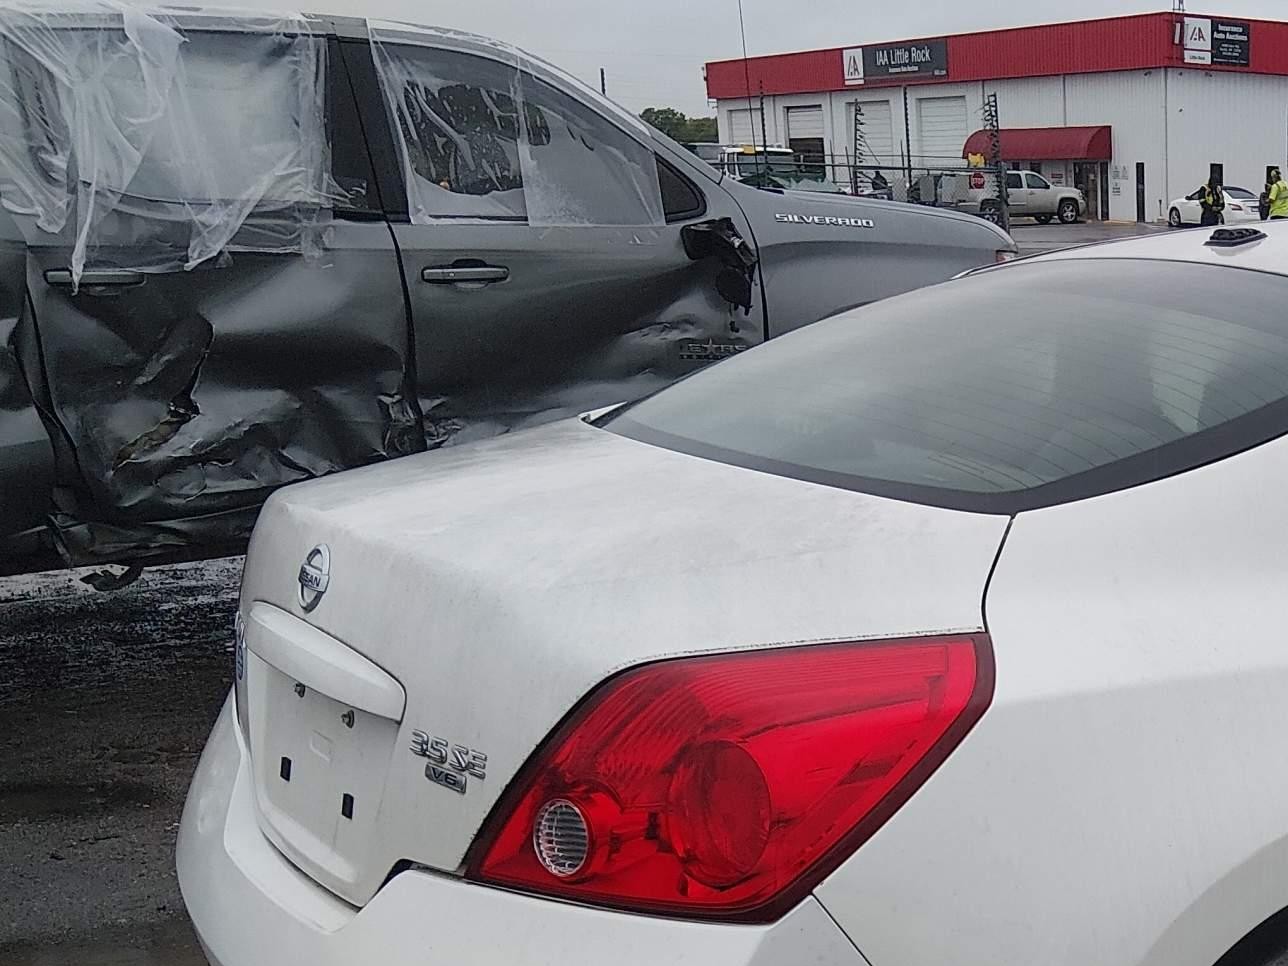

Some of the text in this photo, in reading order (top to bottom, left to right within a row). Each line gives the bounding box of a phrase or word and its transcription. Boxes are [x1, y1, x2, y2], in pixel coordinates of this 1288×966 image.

[876, 45, 931, 66] IAA Little Rock
[775, 213, 874, 228] SILVERADO
[430, 767, 458, 787] V6
